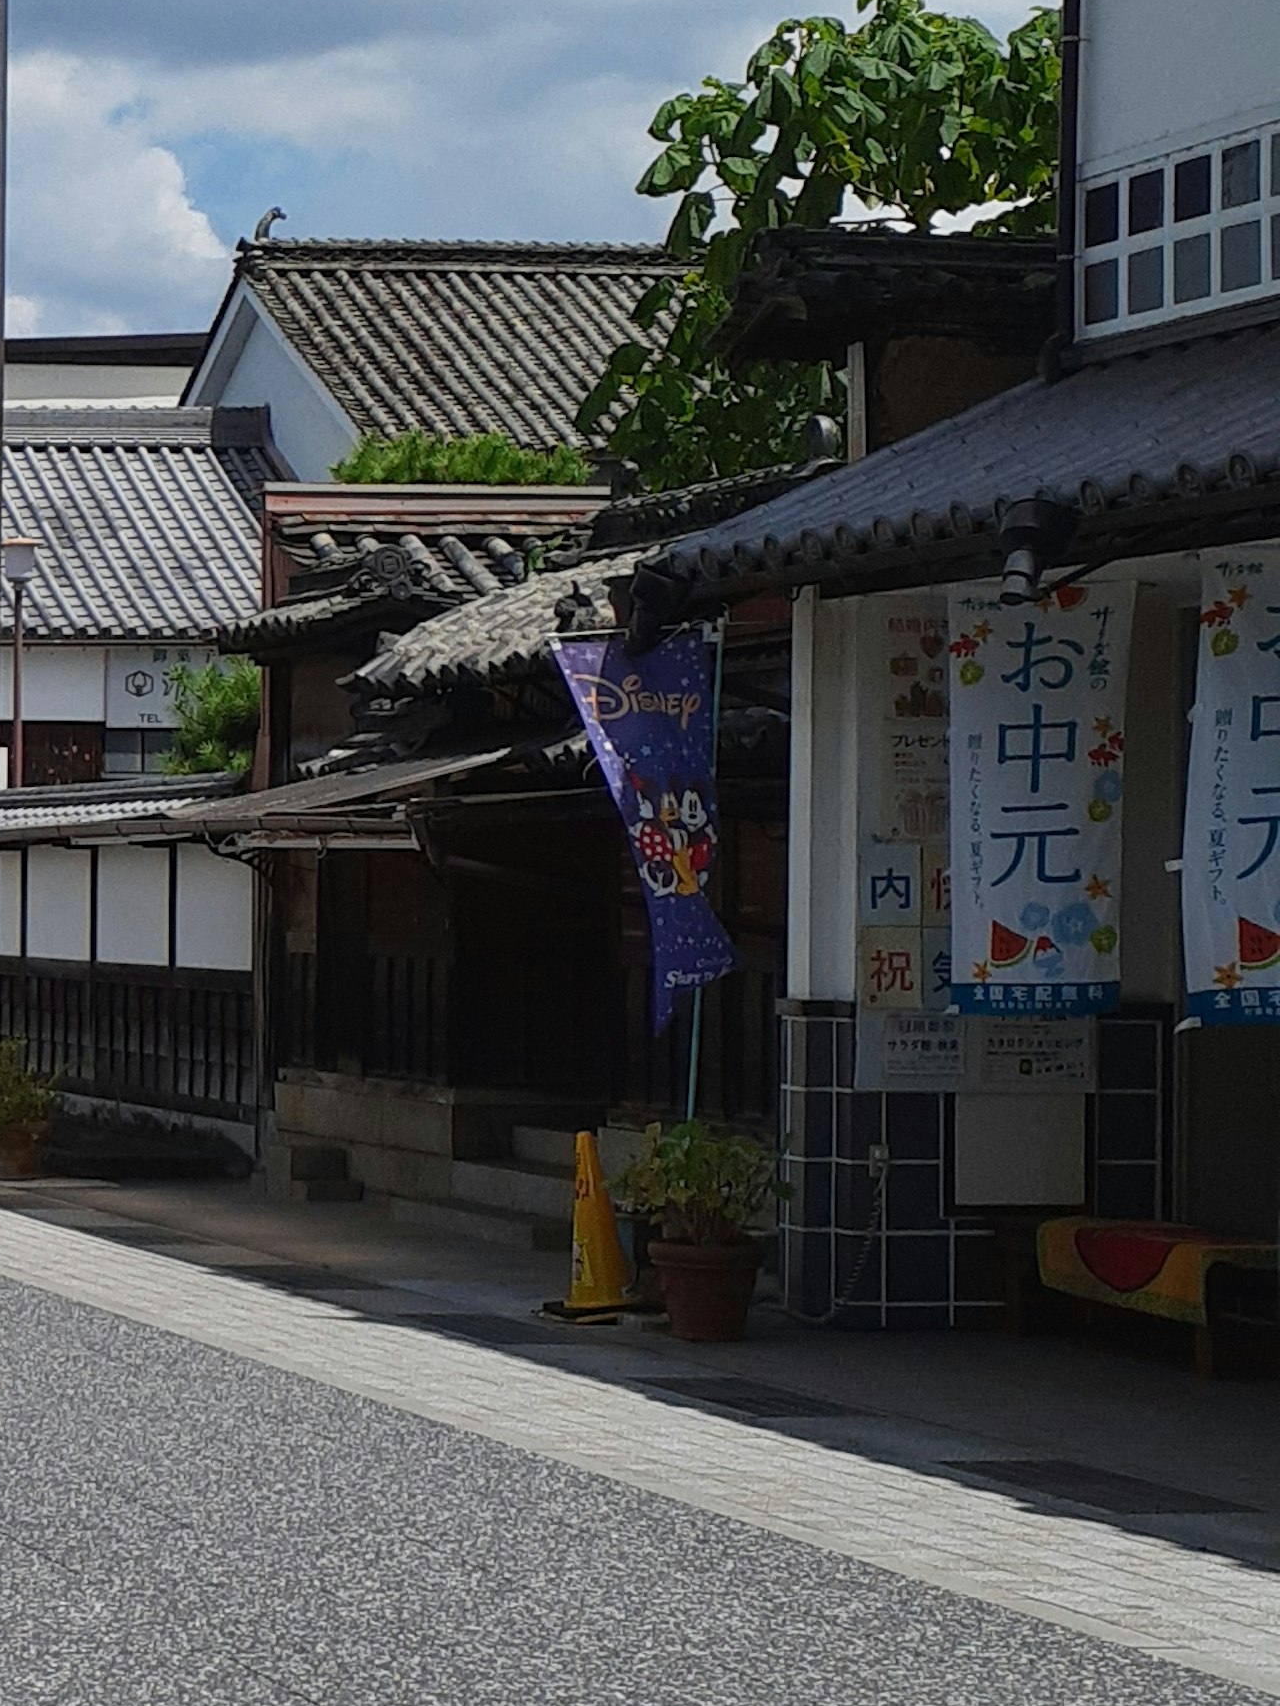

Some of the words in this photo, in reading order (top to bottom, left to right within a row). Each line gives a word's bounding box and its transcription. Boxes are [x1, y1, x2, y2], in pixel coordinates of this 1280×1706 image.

[139, 713, 162, 723] TEL
[573, 673, 701, 730] Disney
[990, 622, 1085, 887] お中元
